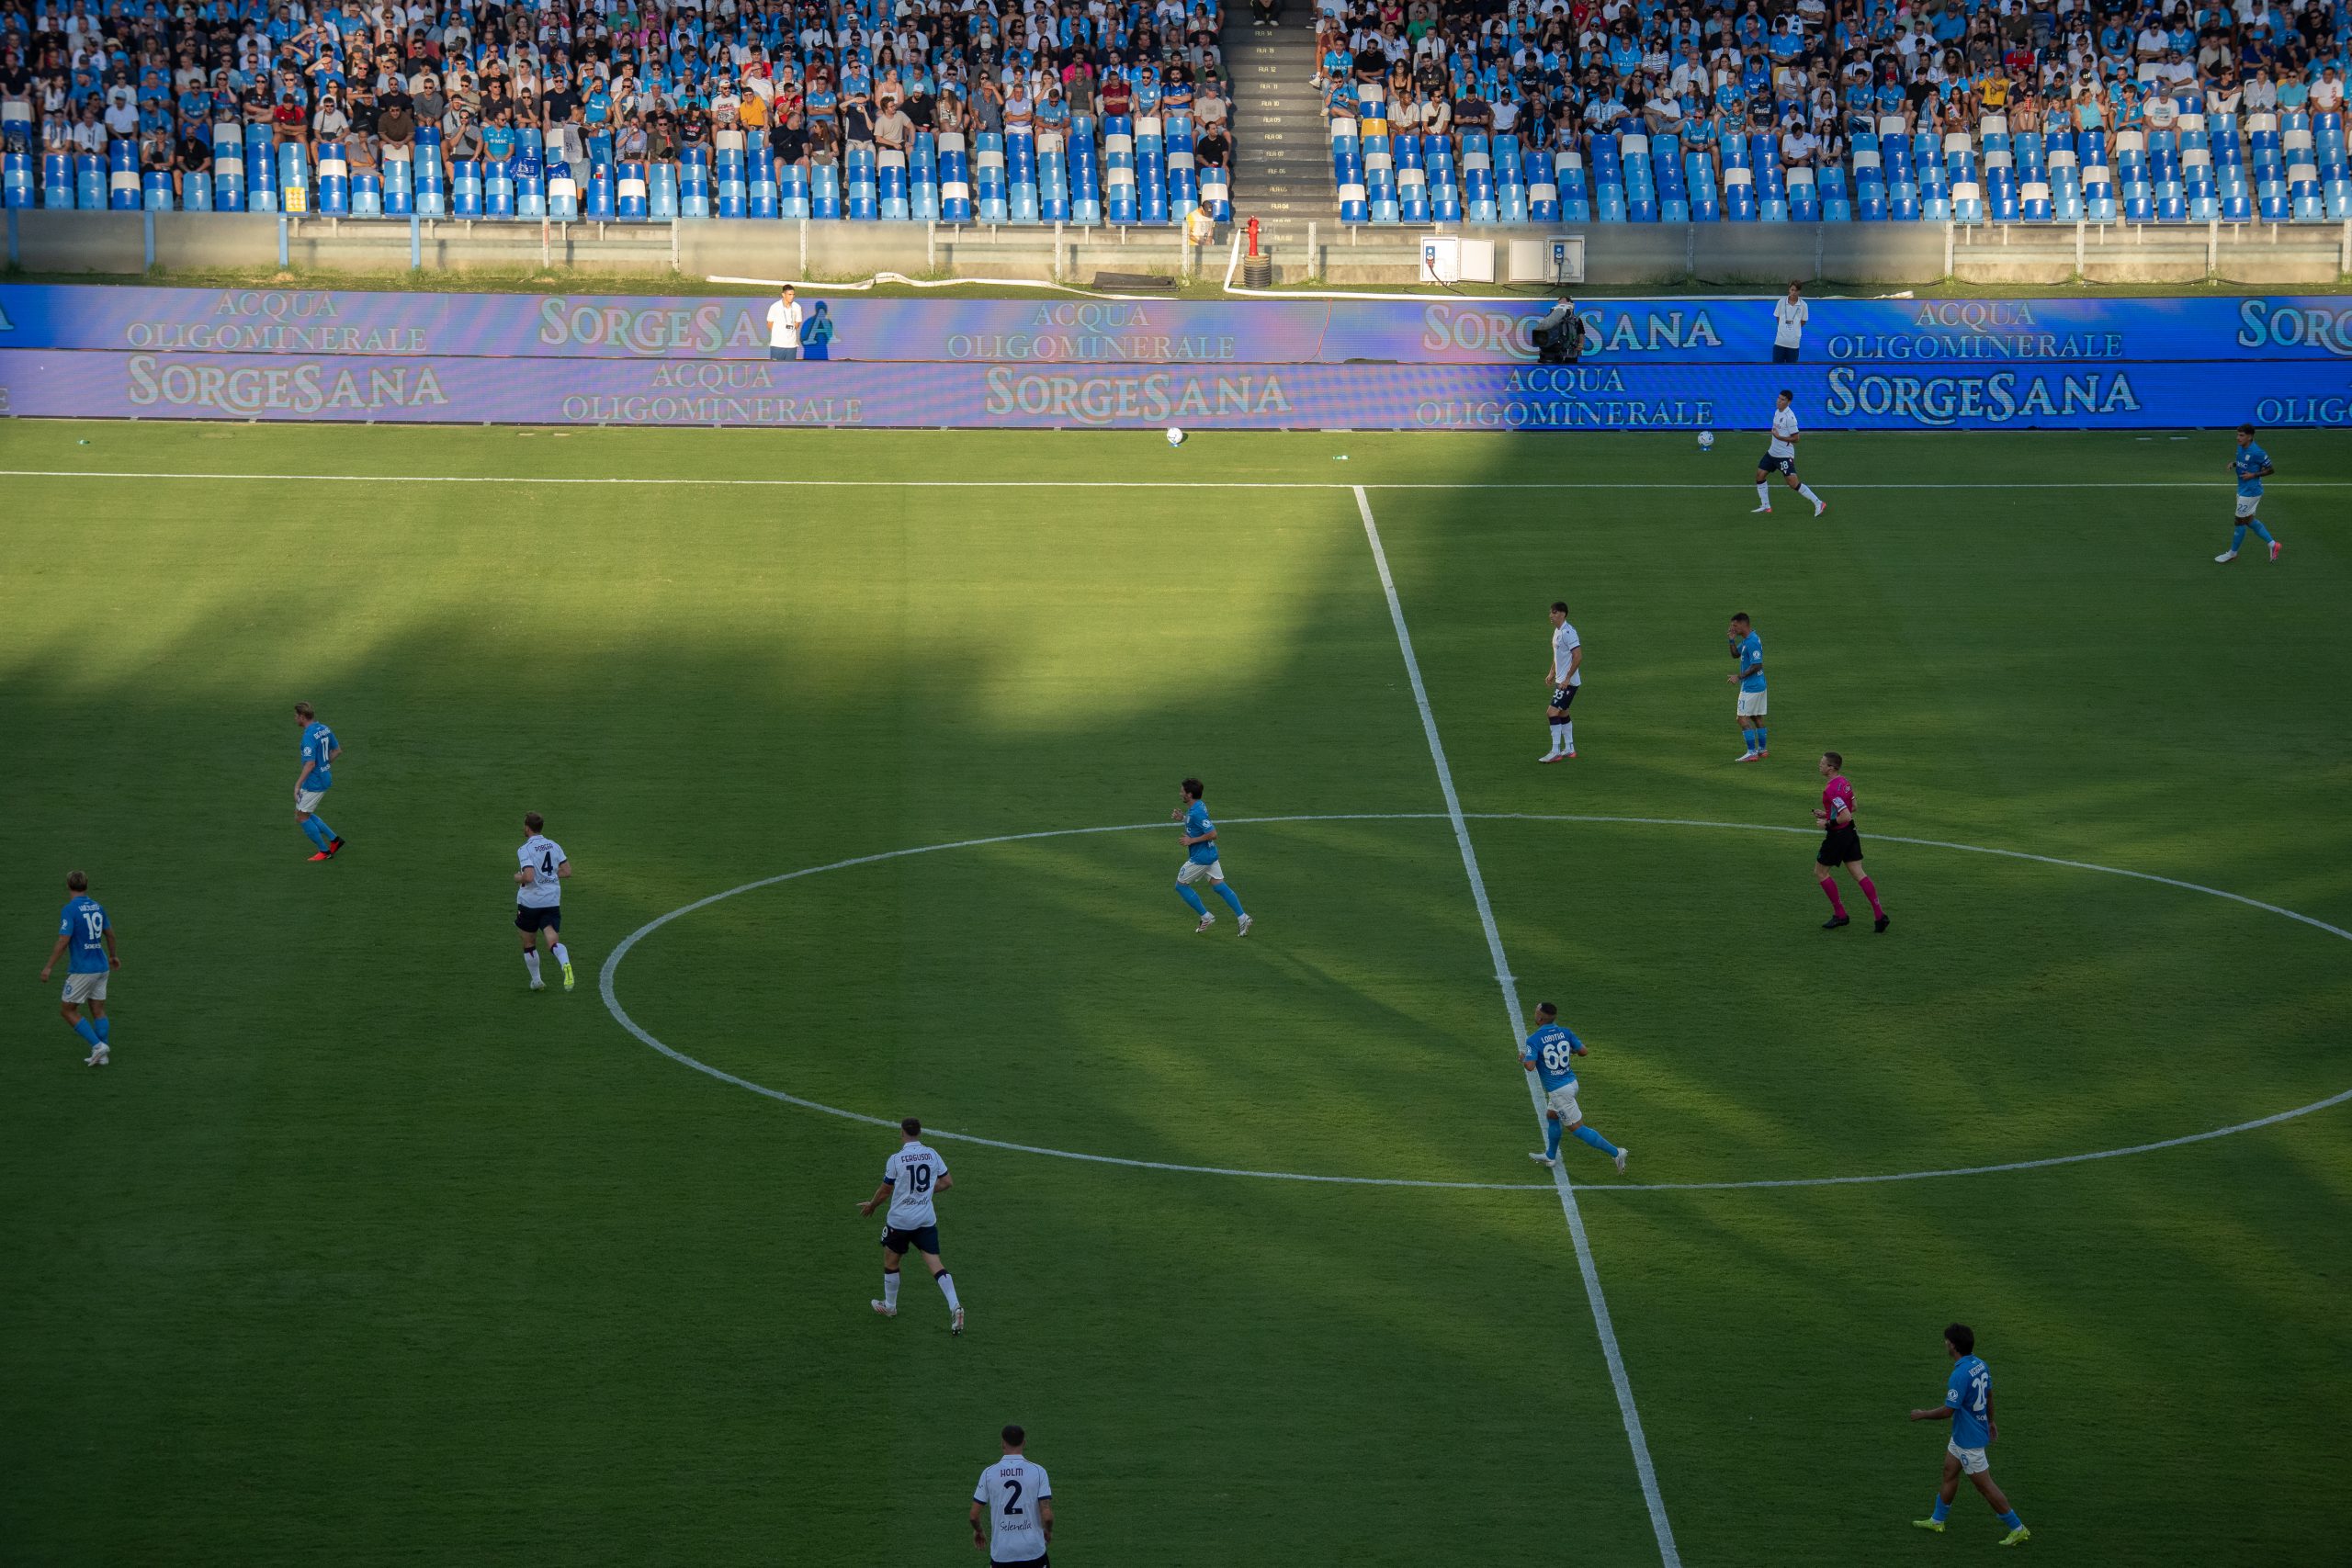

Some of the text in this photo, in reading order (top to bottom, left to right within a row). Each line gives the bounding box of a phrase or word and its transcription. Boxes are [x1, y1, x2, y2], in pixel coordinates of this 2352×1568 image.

[215, 290, 338, 322] ACQUA
[1033, 302, 1151, 333] ACQUA
[1915, 301, 2036, 333] ACQUA
[127, 323, 427, 352] OLIGOMINERALE
[539, 297, 842, 355] SORGESAA
[1423, 303, 1722, 360] SORSANA
[947, 334, 1236, 360] OLIGOMINERALE
[1827, 334, 2123, 360] OLIGOMINERALE
[129, 355, 448, 415] SORGESANA
[652, 364, 774, 395] ACQUA
[1504, 367, 1625, 399] ACQUA
[562, 395, 863, 423] OLIGOMINERALE
[985, 366, 1292, 424] SORGESANA
[1826, 367, 2141, 424] SORGESANA
[1416, 400, 1714, 426] OLIGOMINERALE
[2257, 398, 2352, 423] OLIG
[1780, 460, 1789, 470] 18
[541, 852, 553, 876] 4
[83, 912, 103, 940] 19
[1544, 1041, 1570, 1069] 68
[901, 1153, 933, 1163] FERGUSON
[906, 1164, 930, 1194] 19
[1001, 1468, 1023, 1477] HOLM
[1004, 1480, 1023, 1515] 2
[1000, 1520, 1032, 1531] Selenella
